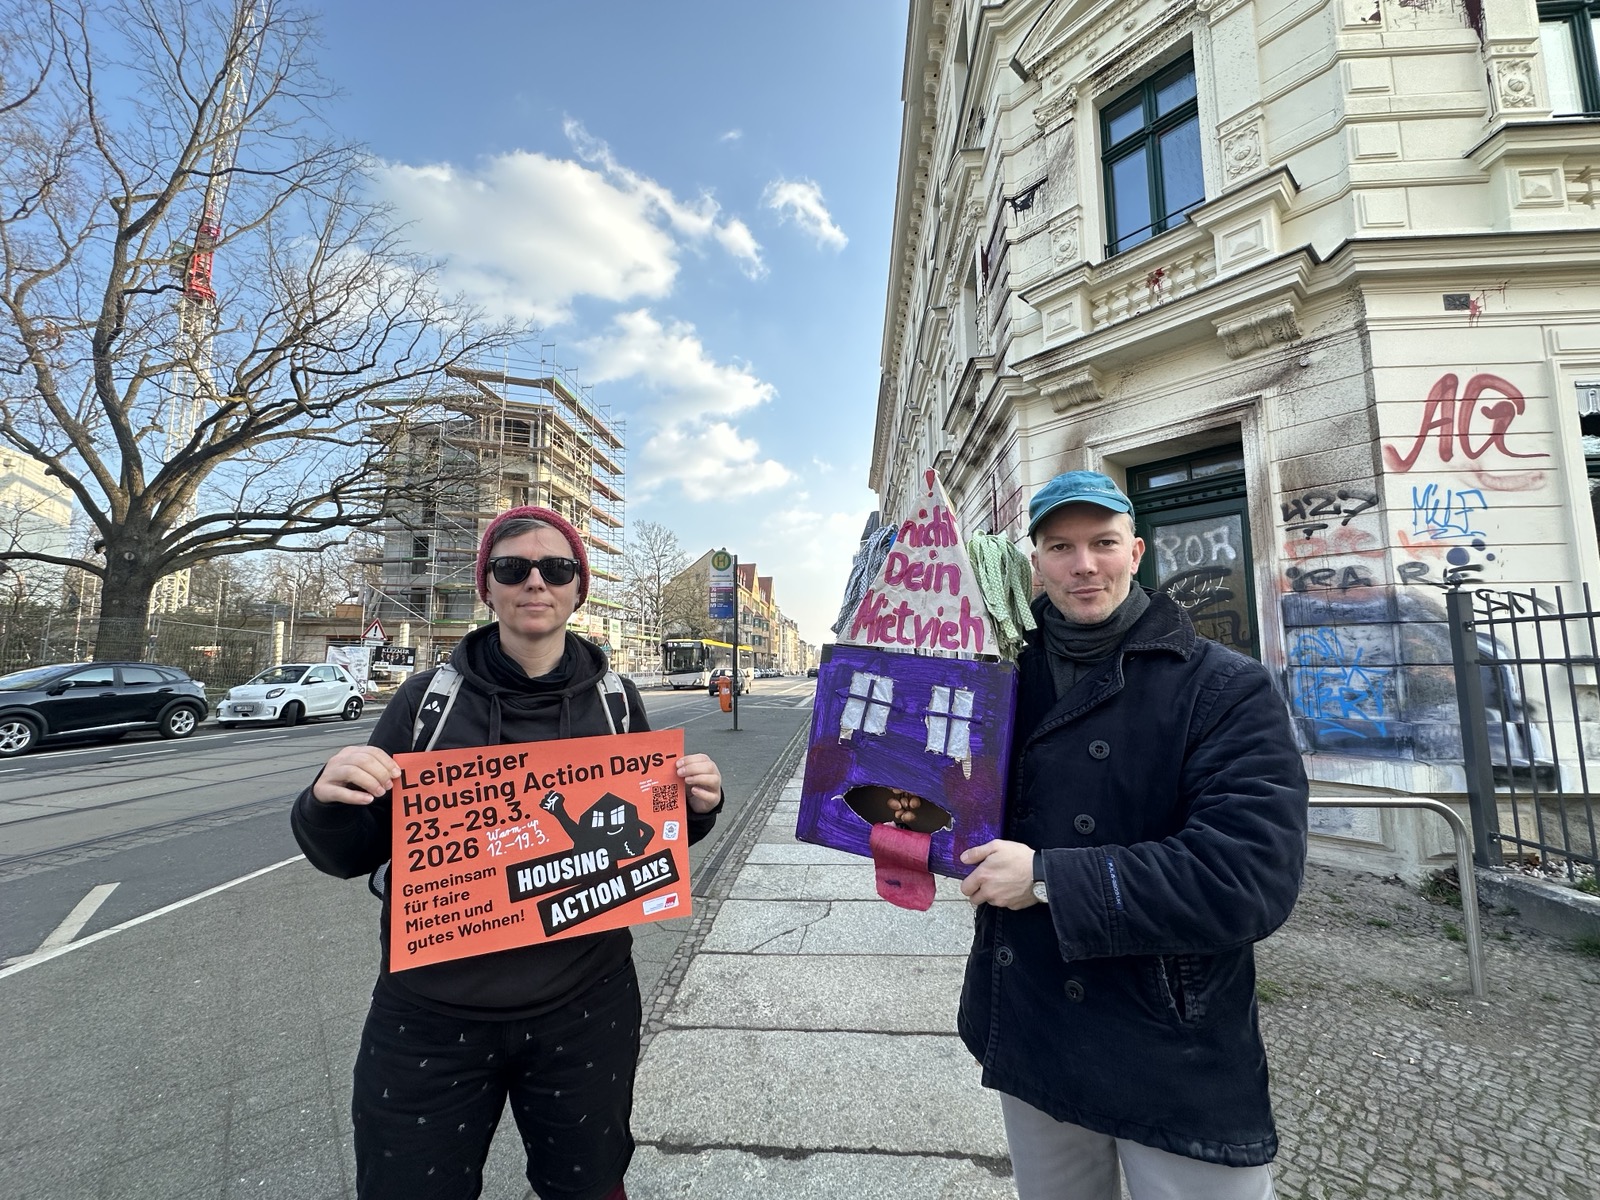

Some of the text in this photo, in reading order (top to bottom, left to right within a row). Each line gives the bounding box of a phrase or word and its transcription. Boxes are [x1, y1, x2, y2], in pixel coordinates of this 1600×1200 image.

[897, 505, 958, 548] nicht
[884, 550, 962, 596] Dein
[851, 589, 985, 653] Mietvieh
[400, 752, 529, 790] Leipziger
[403, 780, 516, 817] Housing
[523, 764, 604, 794] Action
[486, 820, 539, 841] Warm-up
[408, 837, 480, 873] 2026
[517, 848, 610, 893] HOUSING
[402, 866, 497, 898] Gemeinsam
[404, 890, 471, 916] für faire
[551, 857, 670, 927] ACTION DAYS
[405, 900, 493, 934] Mieten und
[407, 909, 525, 955] gutes Wohnen!
